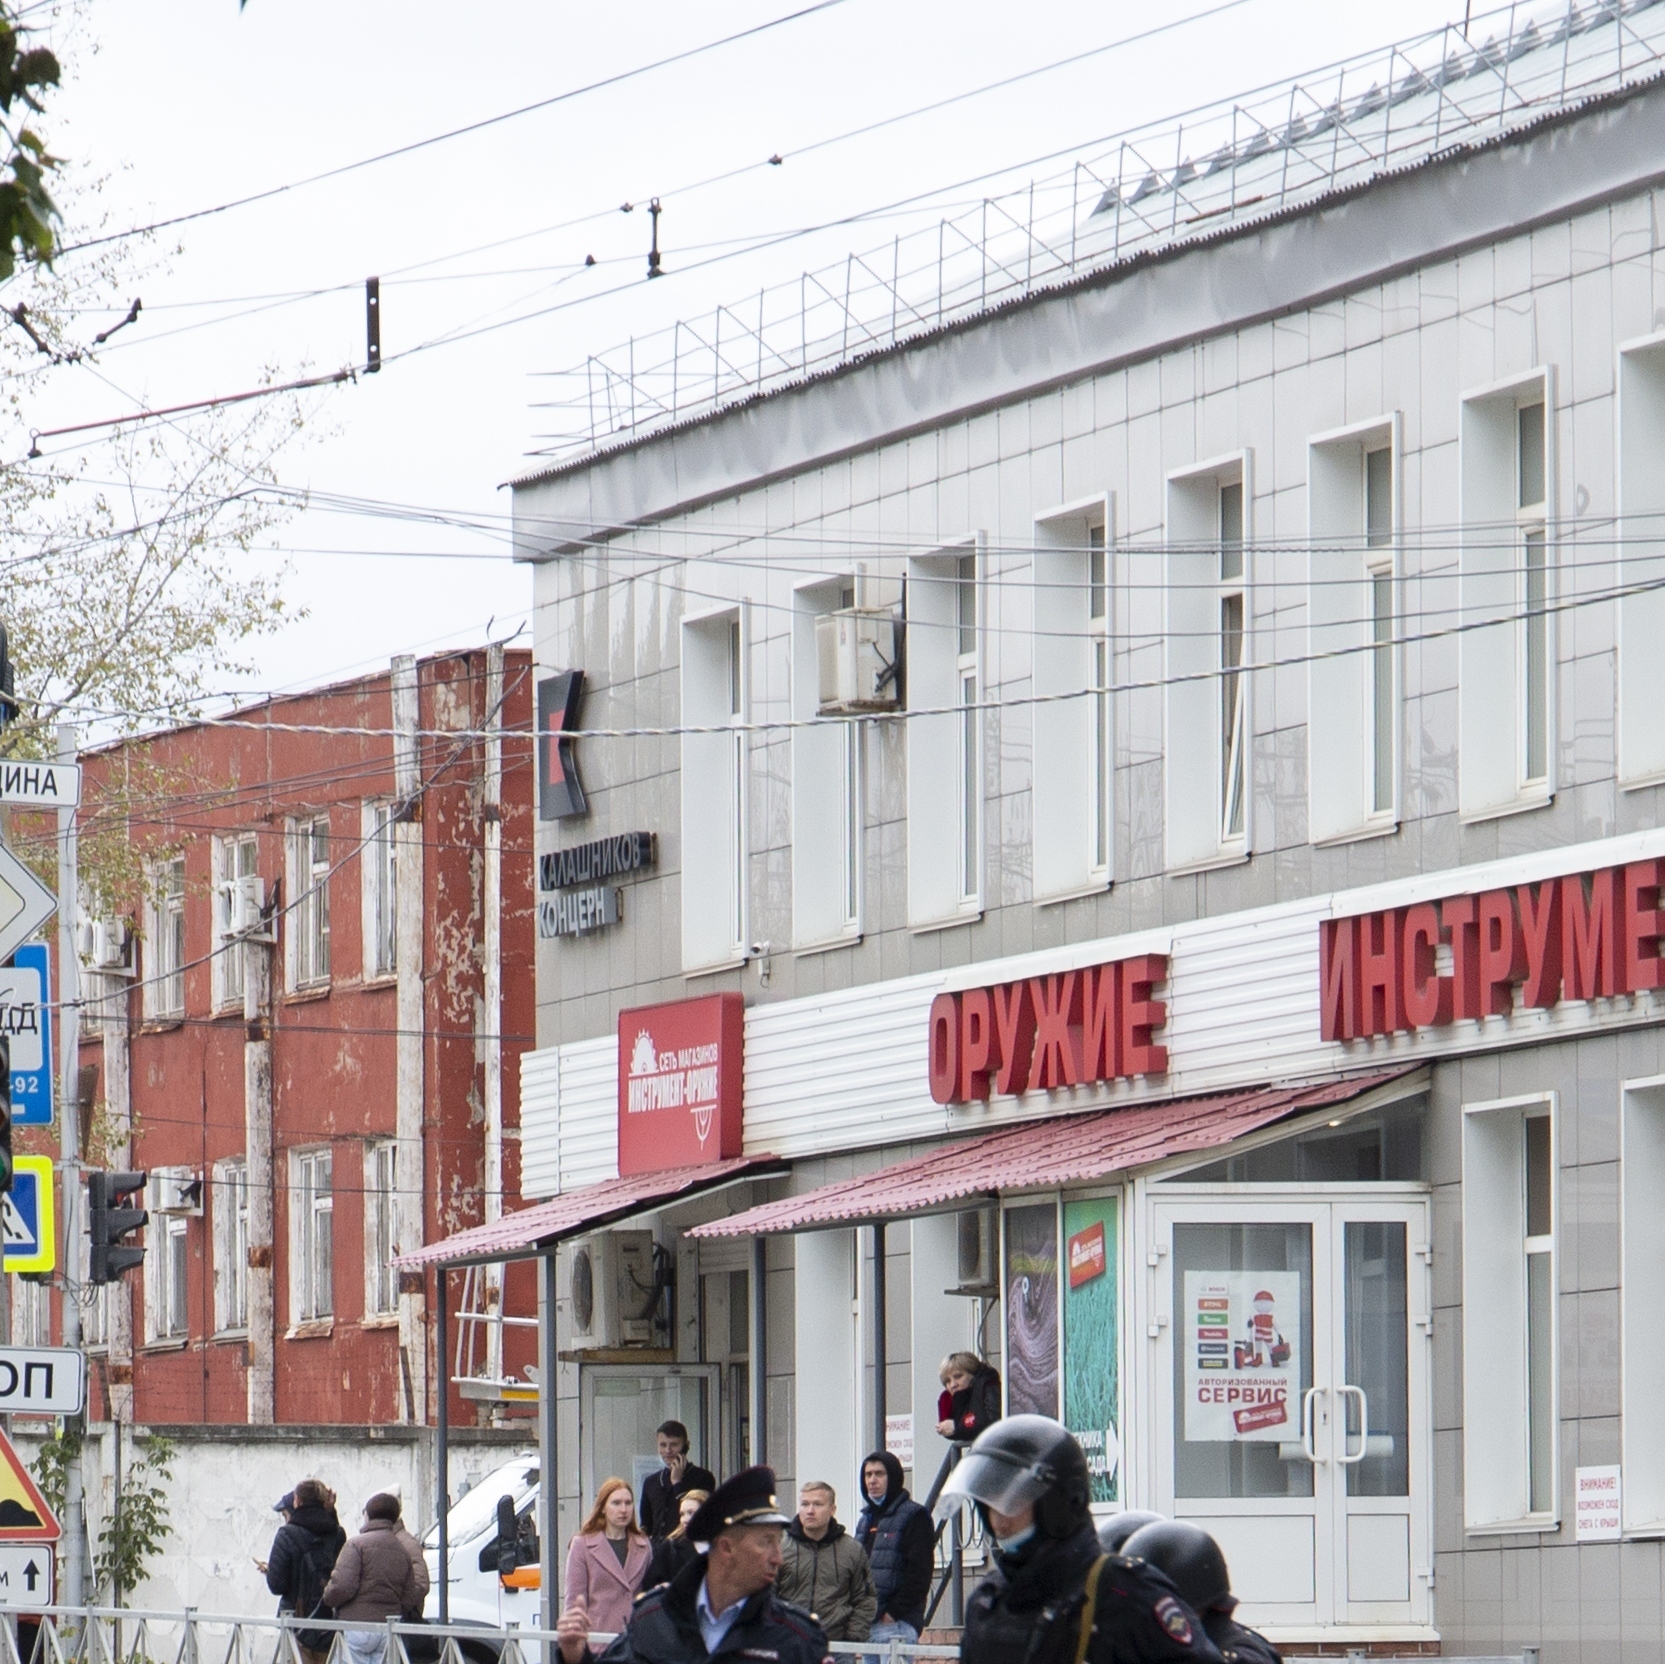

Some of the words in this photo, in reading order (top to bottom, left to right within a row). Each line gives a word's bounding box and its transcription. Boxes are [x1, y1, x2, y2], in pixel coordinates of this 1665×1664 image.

[540, 832, 641, 892] КАЛАШНИКОВ
[540, 887, 606, 938] КОНЦЕРН
[928, 953, 1168, 1105] ОРУЖИЕ
[659, 1052, 677, 1073] СЕТЬ
[678, 1042, 718, 1069] МАГАЗИНОВ
[628, 1065, 718, 1114] ИНСТРУМЕНТ-ОРУЖИЕ
[1198, 1376, 1288, 1387] АВТОРИЗОВАННЫЙ
[1198, 1387, 1288, 1404] СЕРВИС
